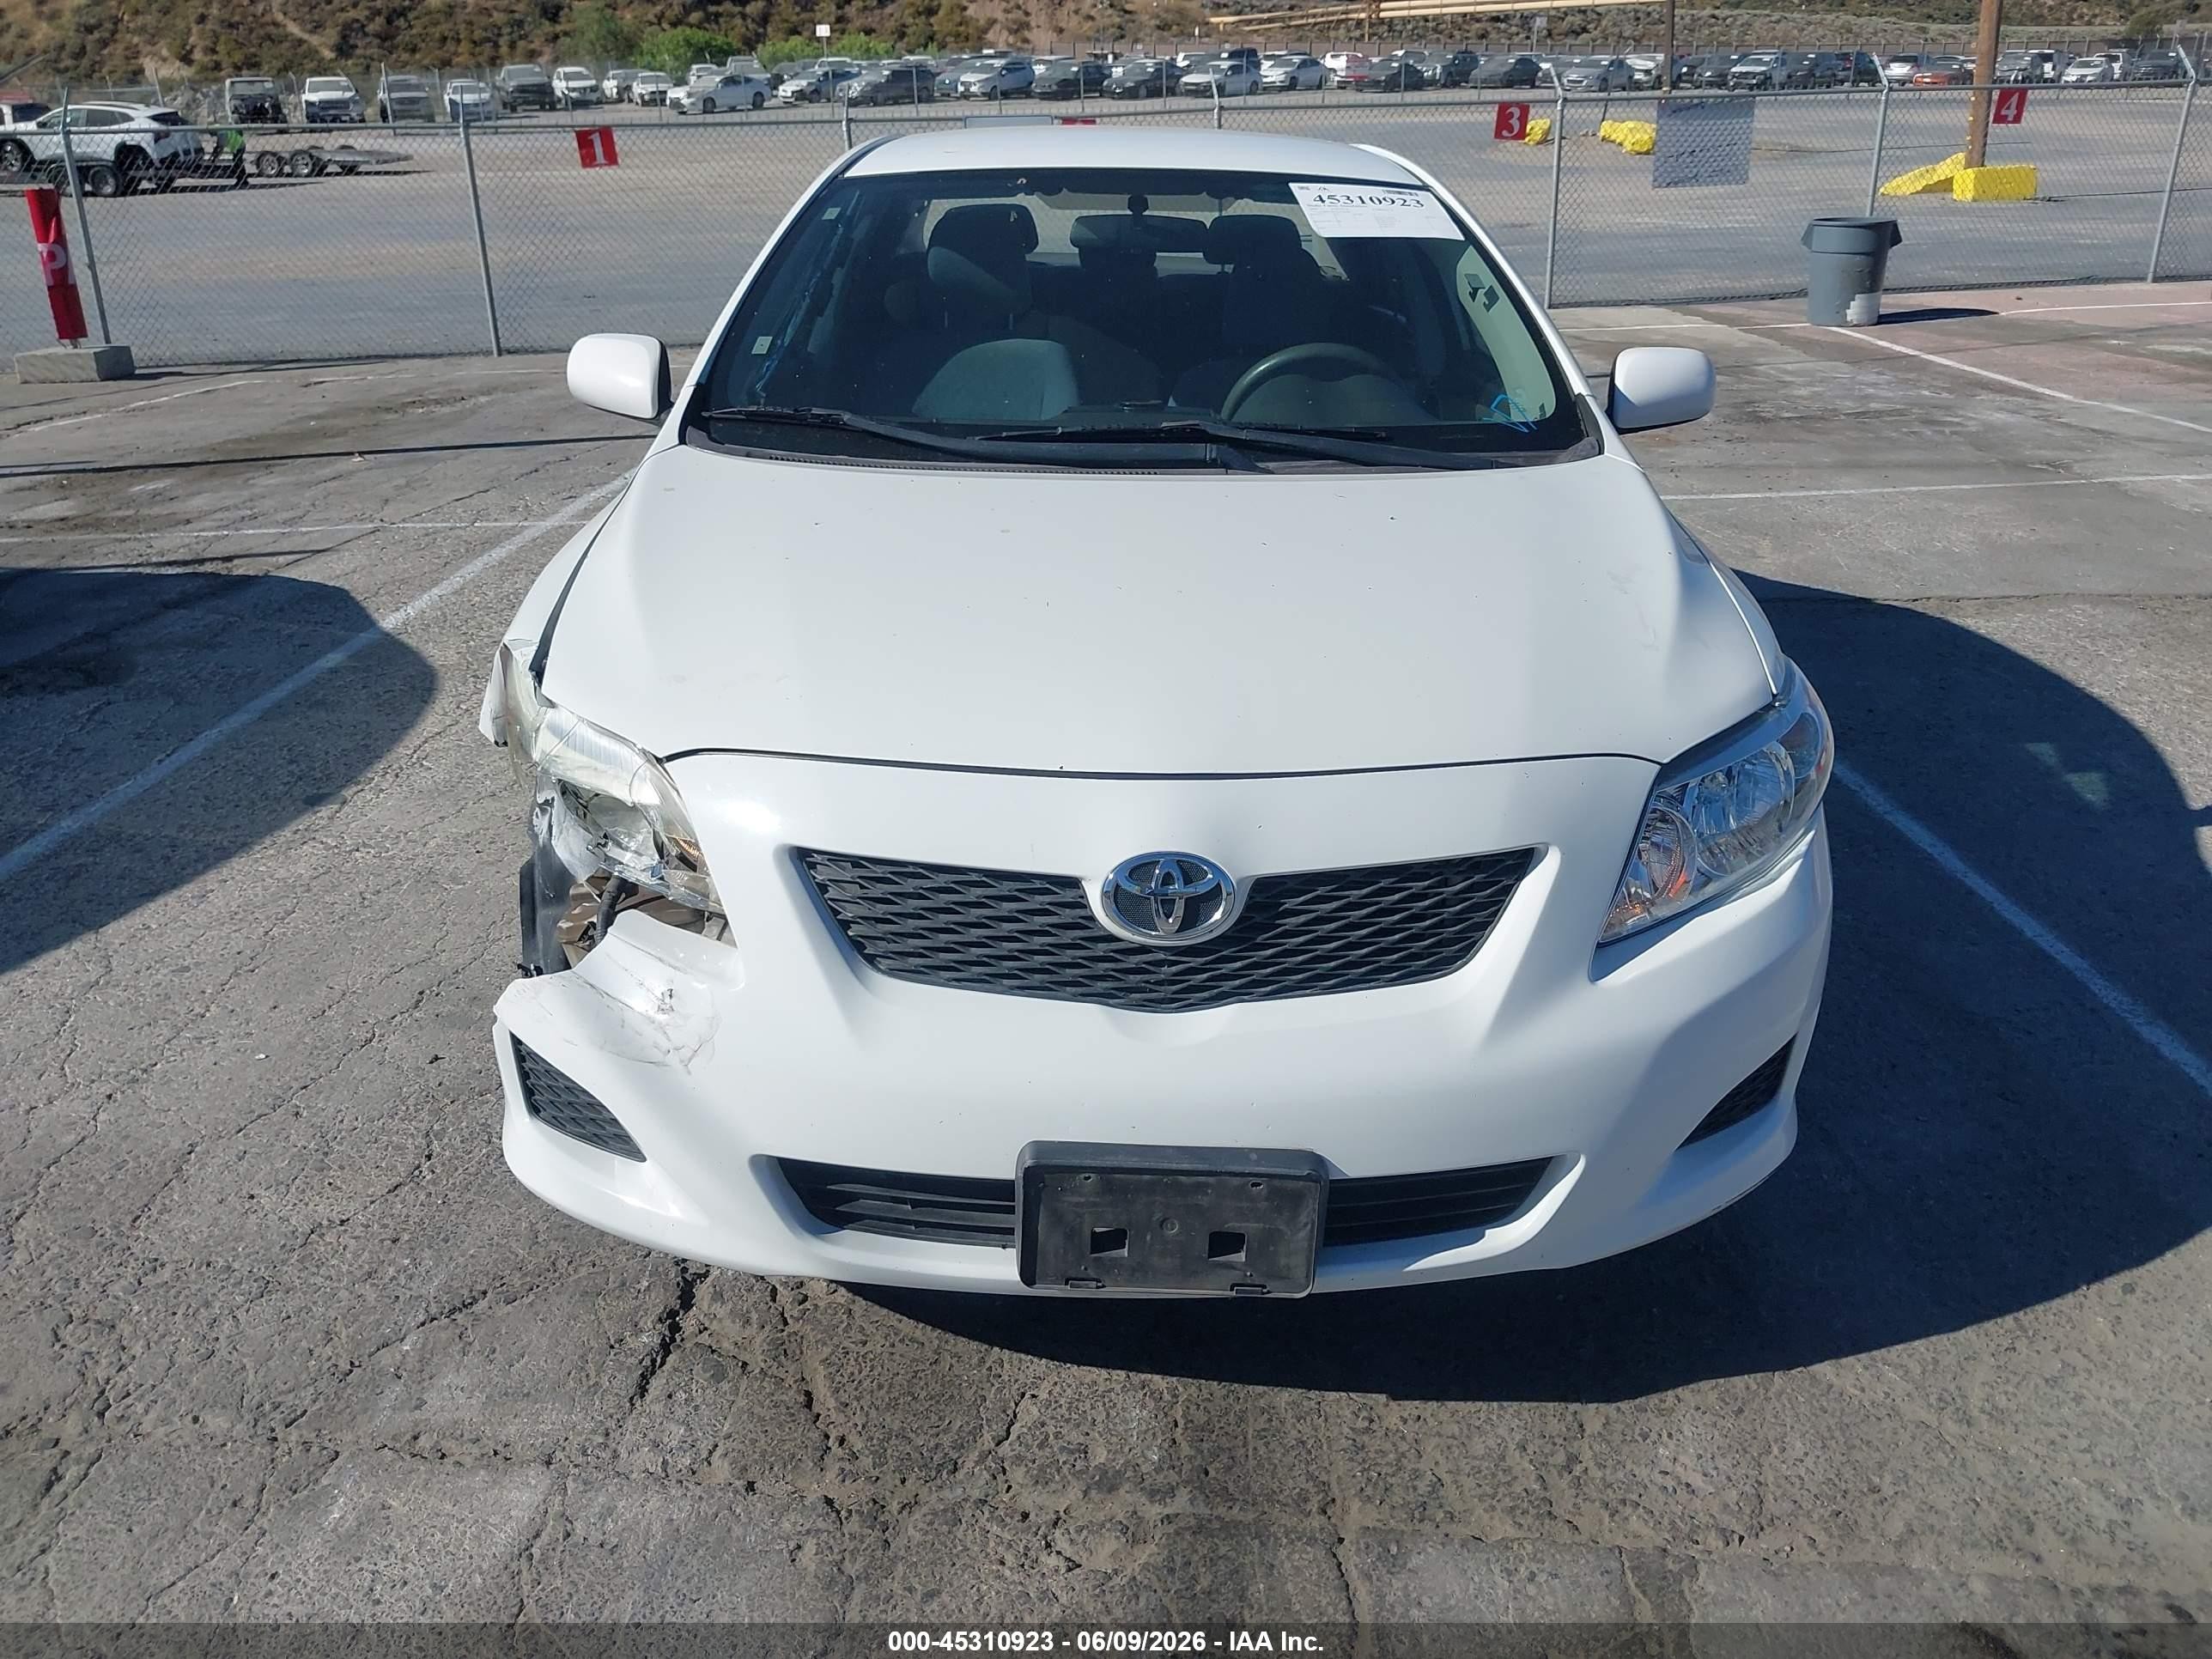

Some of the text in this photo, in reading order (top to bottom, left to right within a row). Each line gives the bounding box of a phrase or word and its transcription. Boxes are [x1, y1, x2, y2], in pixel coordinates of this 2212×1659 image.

[2000, 91, 2020, 121] 4
[1501, 106, 1521, 137] 3
[588, 131, 609, 165] 1
[1313, 193, 1425, 209] 45310923
